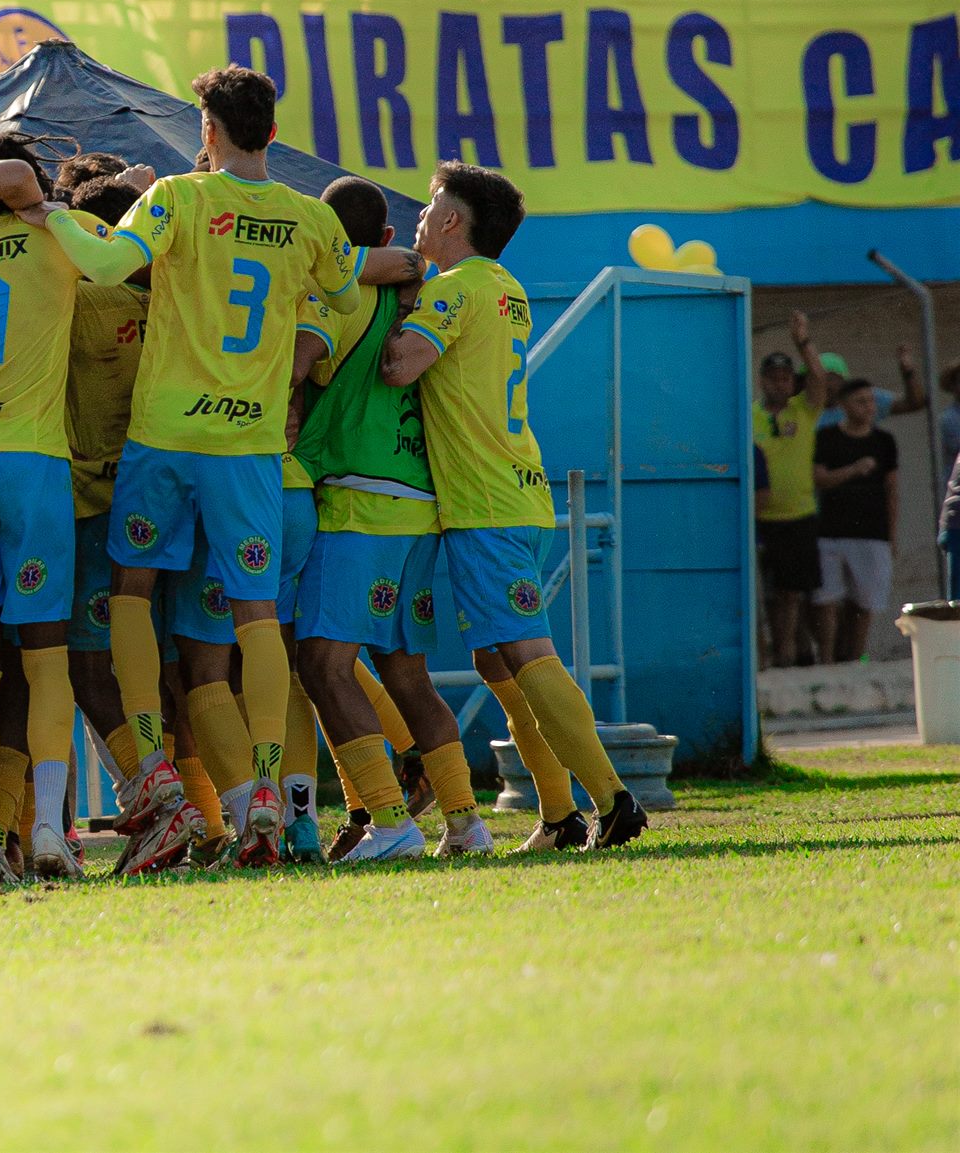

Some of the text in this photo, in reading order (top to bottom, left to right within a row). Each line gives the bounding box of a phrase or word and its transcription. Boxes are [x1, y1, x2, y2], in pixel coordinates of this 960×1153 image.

[225, 7, 740, 170] PIRATAS
[234, 214, 299, 248] FENIX
[222, 257, 271, 354] 3
[507, 338, 528, 435] 2
